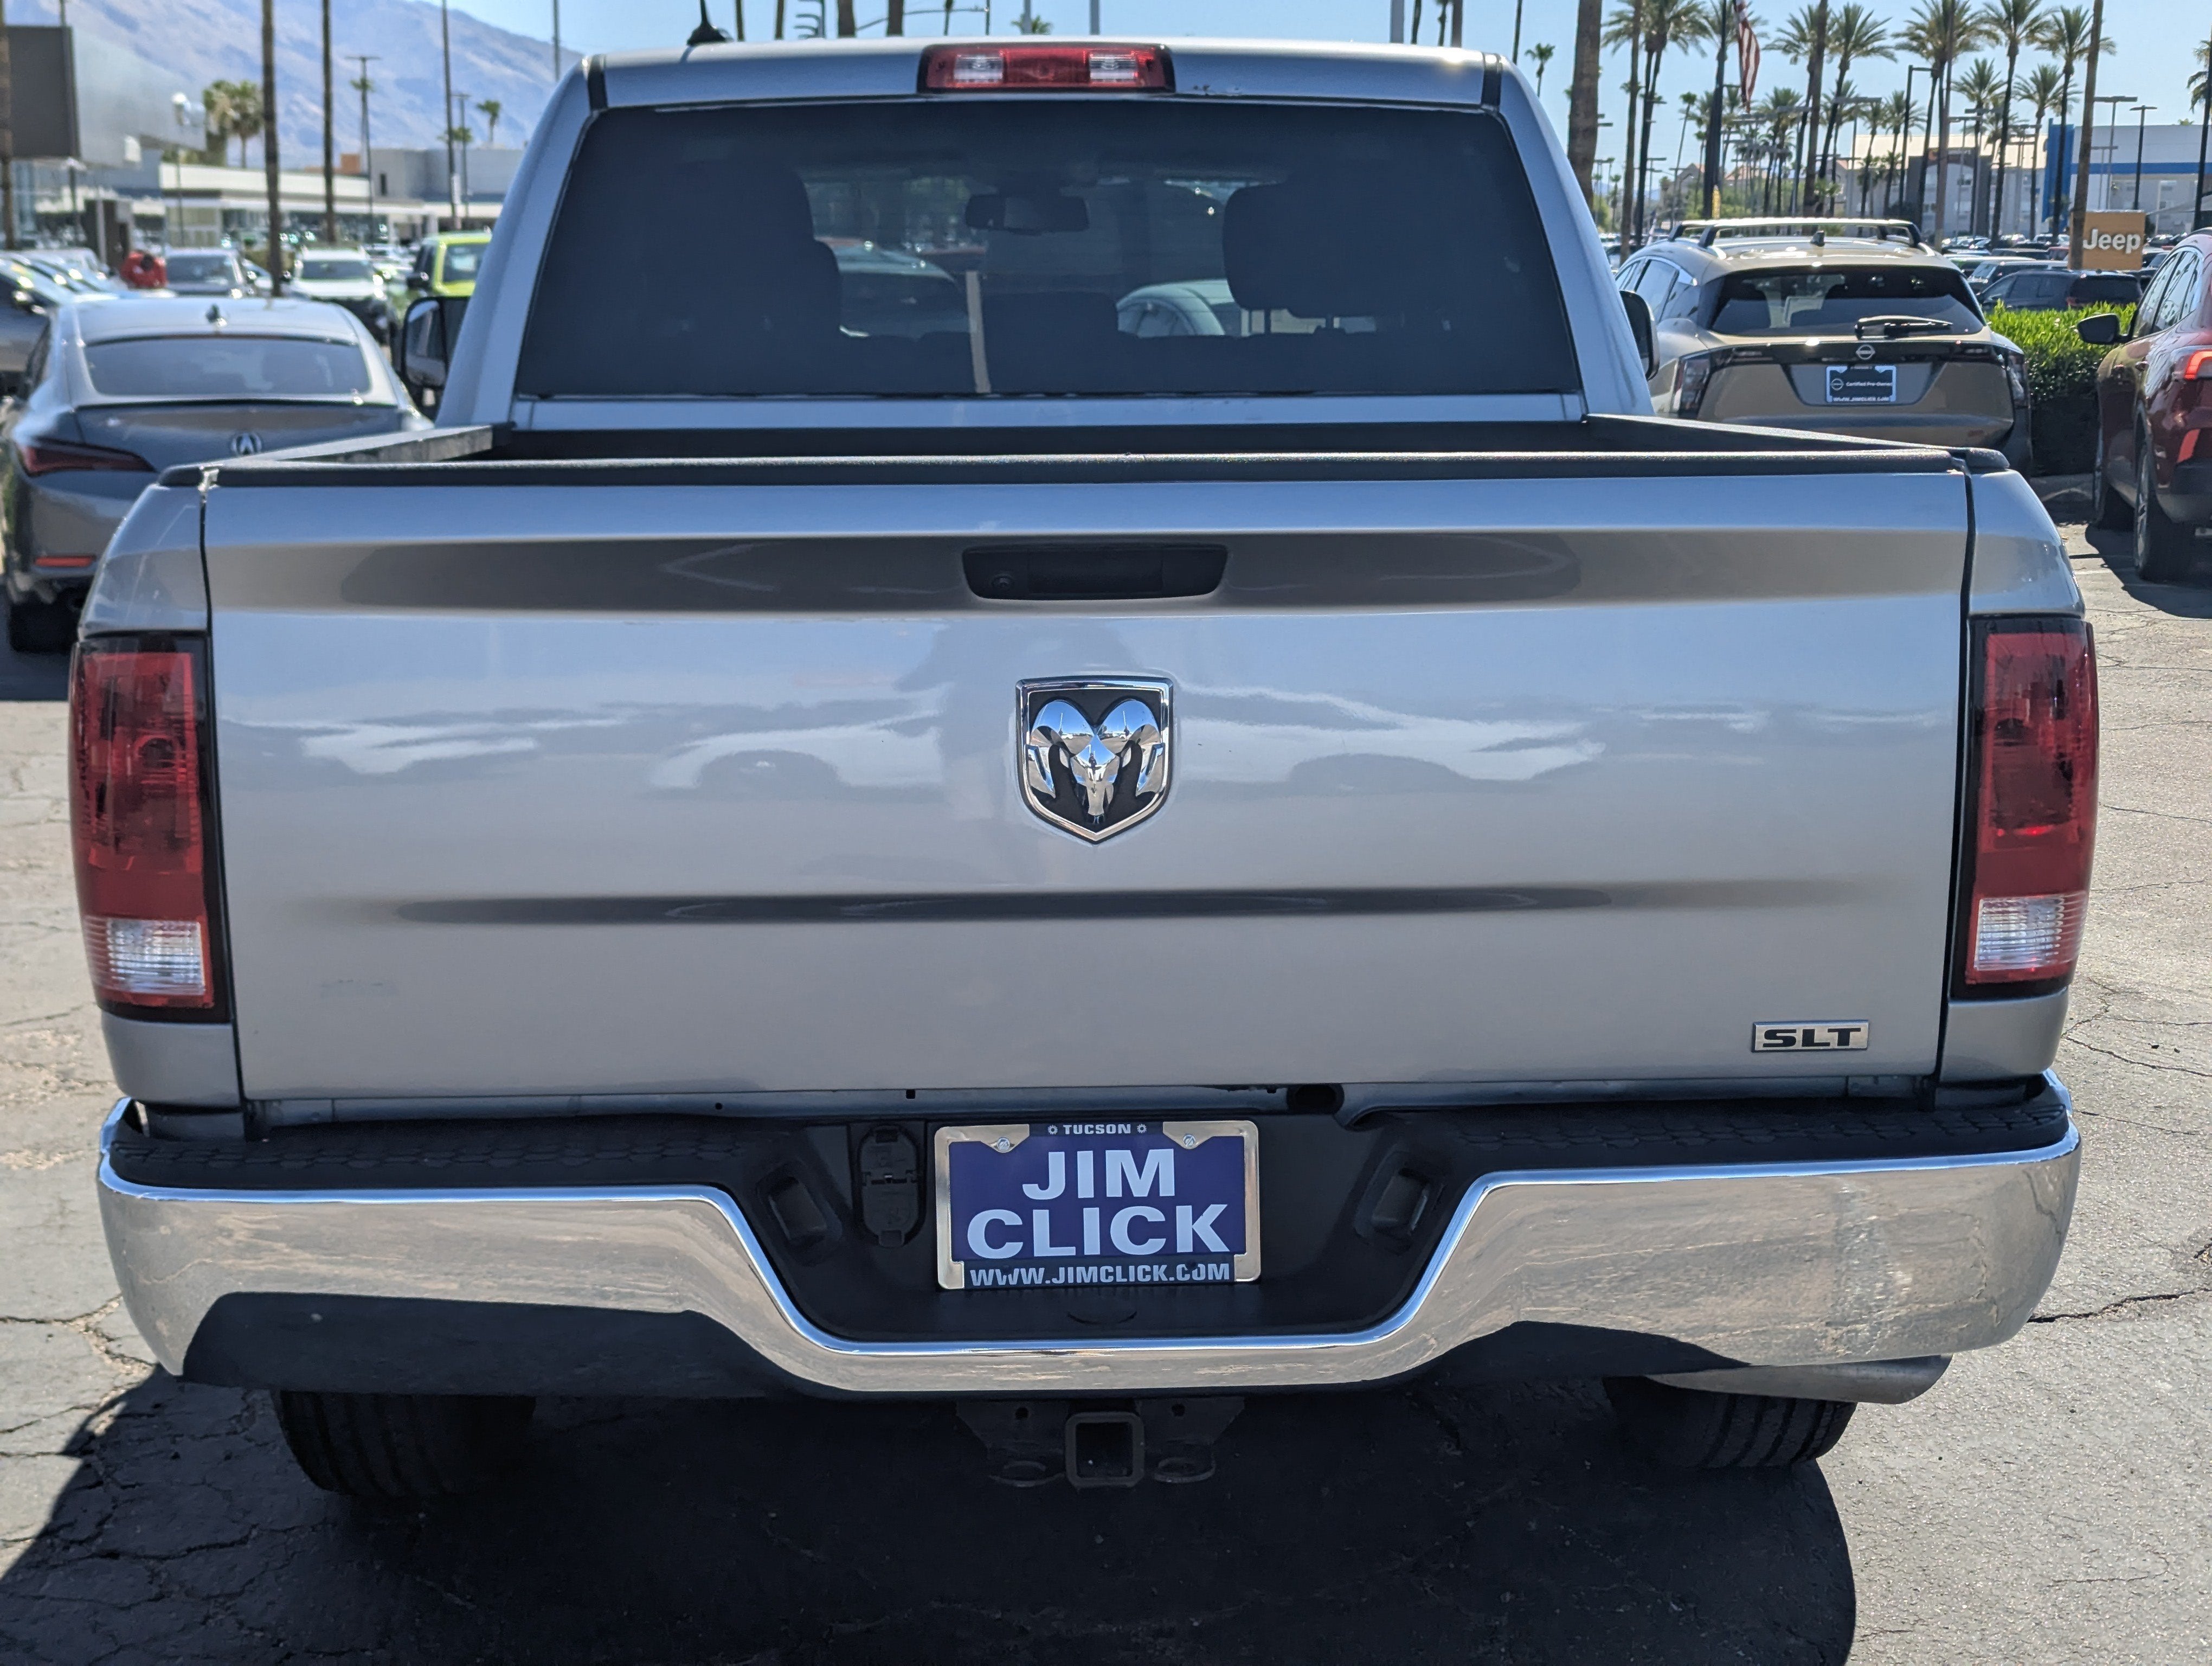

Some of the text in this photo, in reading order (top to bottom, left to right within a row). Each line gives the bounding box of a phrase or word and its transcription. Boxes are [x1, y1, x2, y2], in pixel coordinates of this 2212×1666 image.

[2082, 229, 2141, 254] Jeep
[1763, 1028, 1861, 1048] SLT
[1063, 1124, 1131, 1135] TUCSON
[1022, 1149, 1175, 1200] JIM
[967, 1204, 1230, 1259] CLICK
[970, 1263, 1230, 1287] WWW.JIMCLICK.COM
